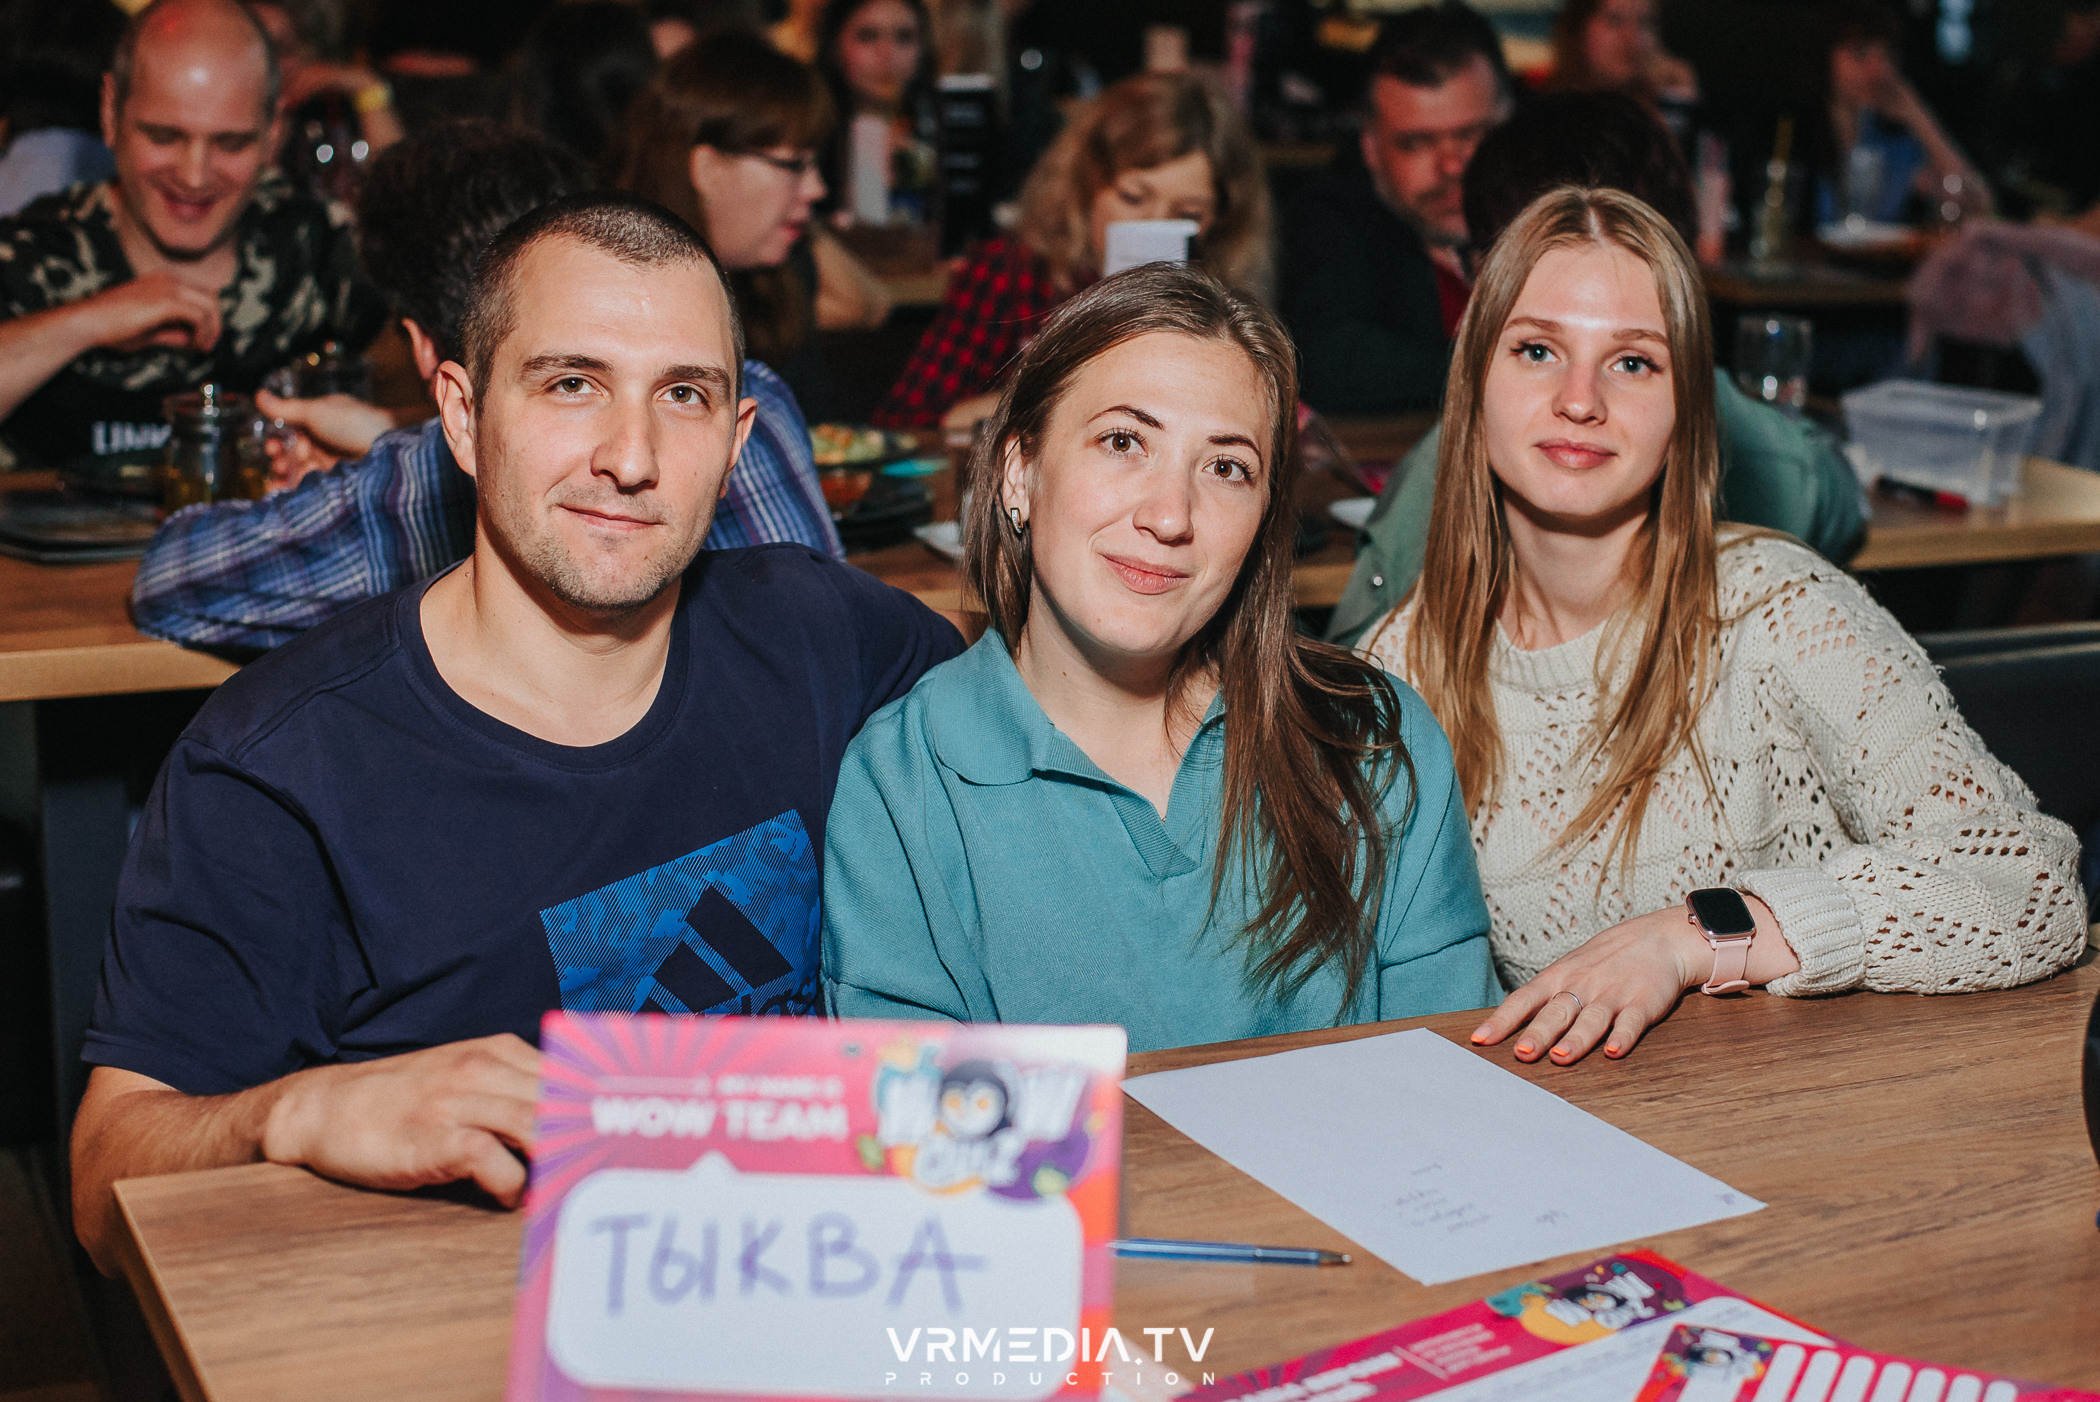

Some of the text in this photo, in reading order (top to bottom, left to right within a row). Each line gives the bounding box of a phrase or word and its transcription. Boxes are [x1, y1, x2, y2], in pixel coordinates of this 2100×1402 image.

[591, 1097, 849, 1143] WOW TEAM
[588, 1211, 987, 1317] ТЫКВА
